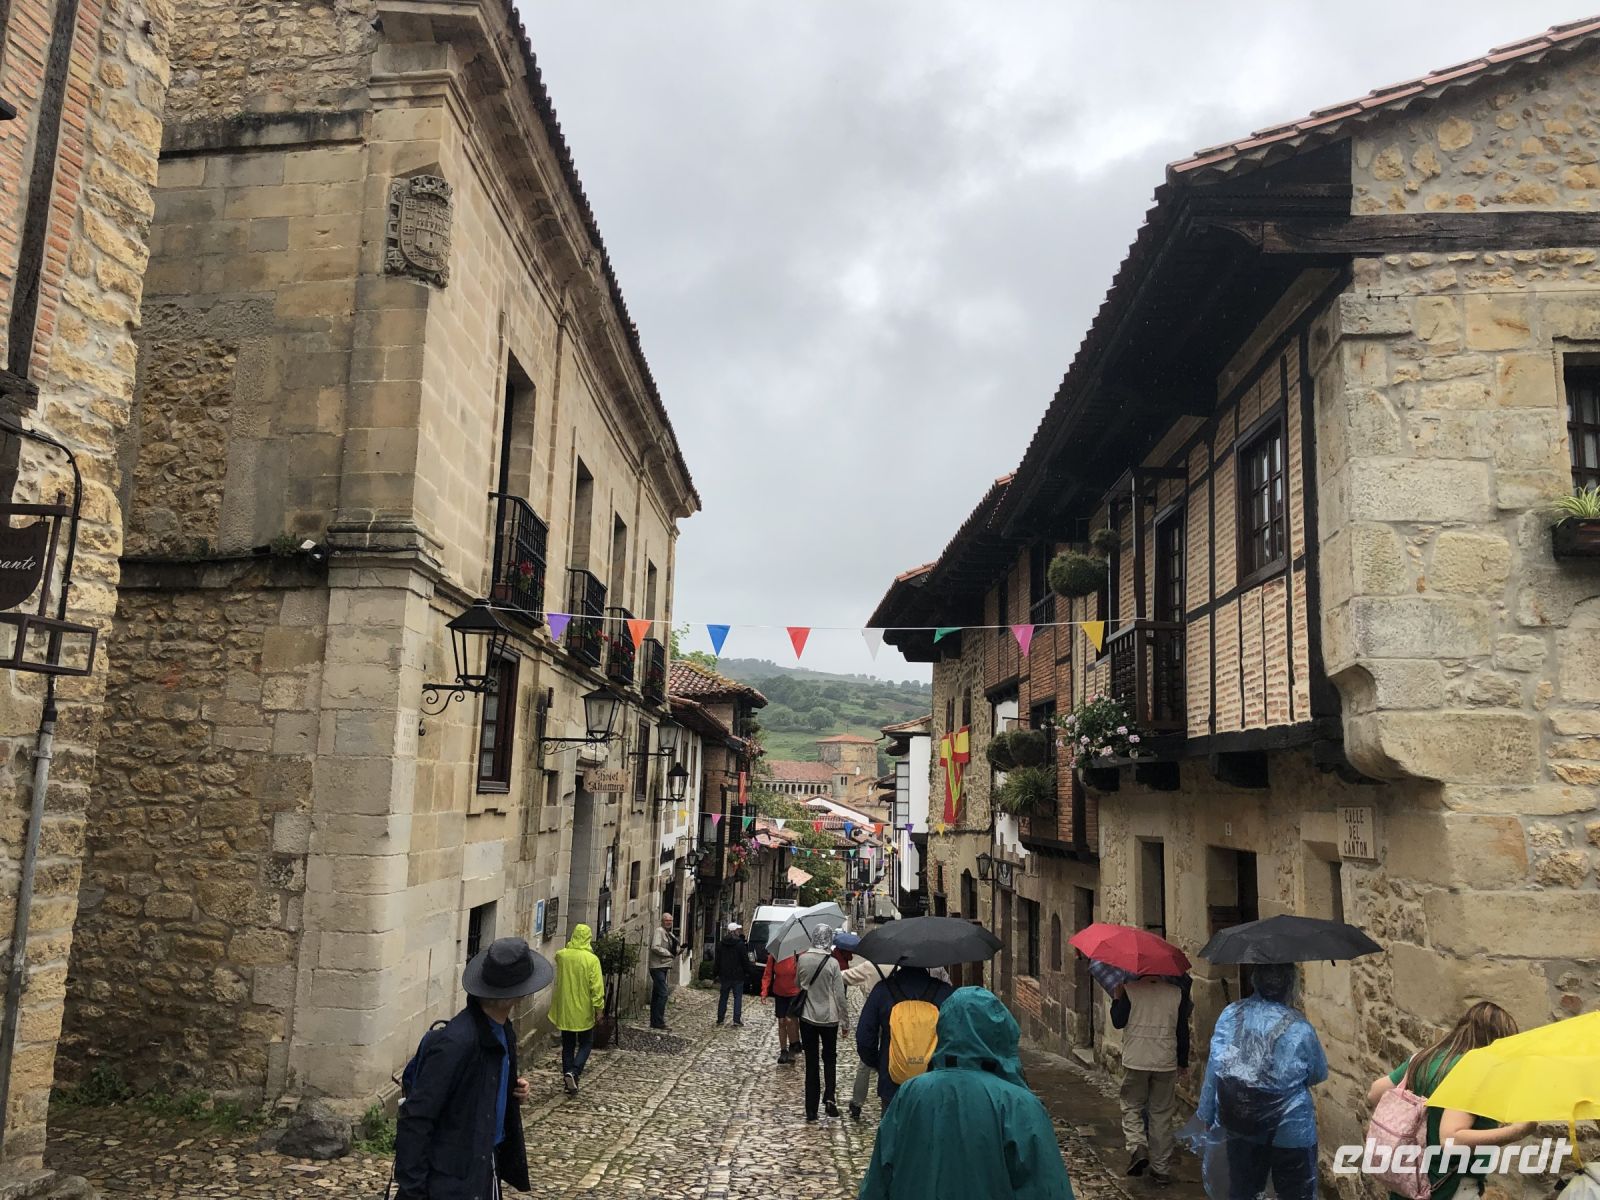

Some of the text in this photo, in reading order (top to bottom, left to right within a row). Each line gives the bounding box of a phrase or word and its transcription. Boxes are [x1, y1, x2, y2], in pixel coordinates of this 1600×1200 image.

[595, 769, 619, 781] Hotel
[1344, 809, 1364, 824] CALLE
[1348, 825, 1360, 840] DEL
[1343, 840, 1367, 856] CANTON
